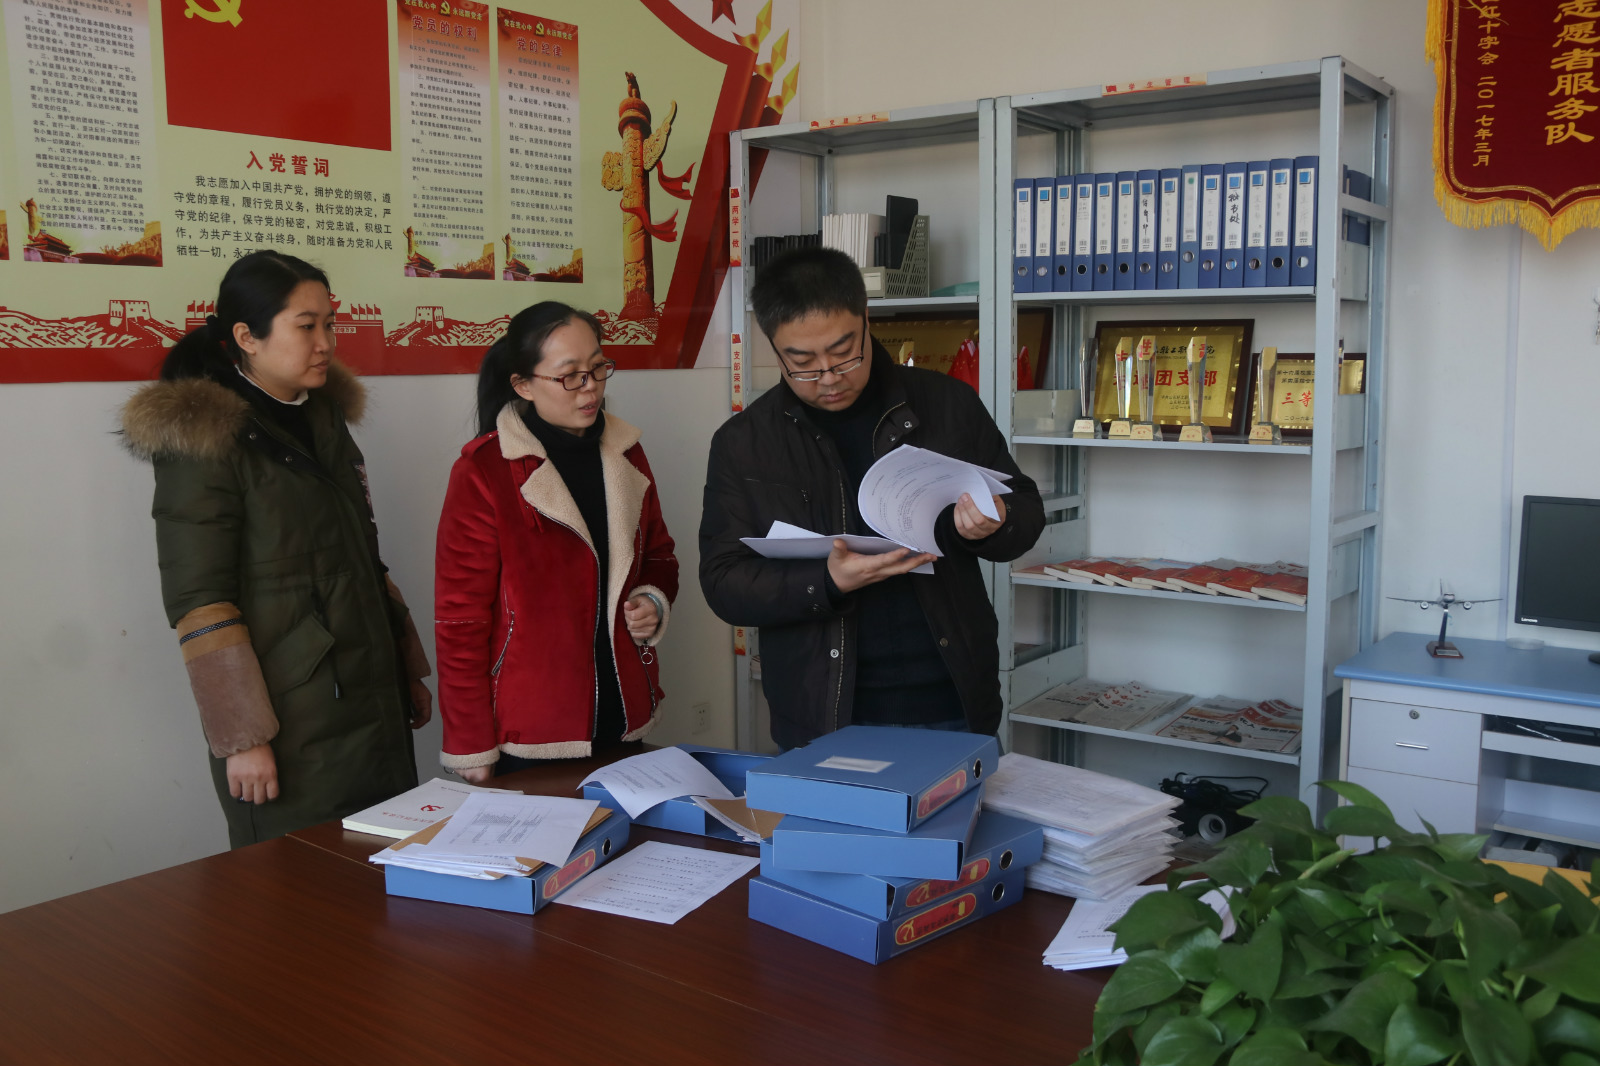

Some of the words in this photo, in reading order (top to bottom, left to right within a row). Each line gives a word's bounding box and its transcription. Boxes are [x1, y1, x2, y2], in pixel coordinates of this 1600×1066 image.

[412, 15, 477, 41] 党员的权利
[1477, 0, 1501, 65] 红十字会
[517, 37, 563, 57] 党的纪律
[1544, 0, 1600, 146] 志愿者服务队
[246, 150, 330, 178] 入党誓词
[176, 245, 256, 259] 牺牲一切，永不
